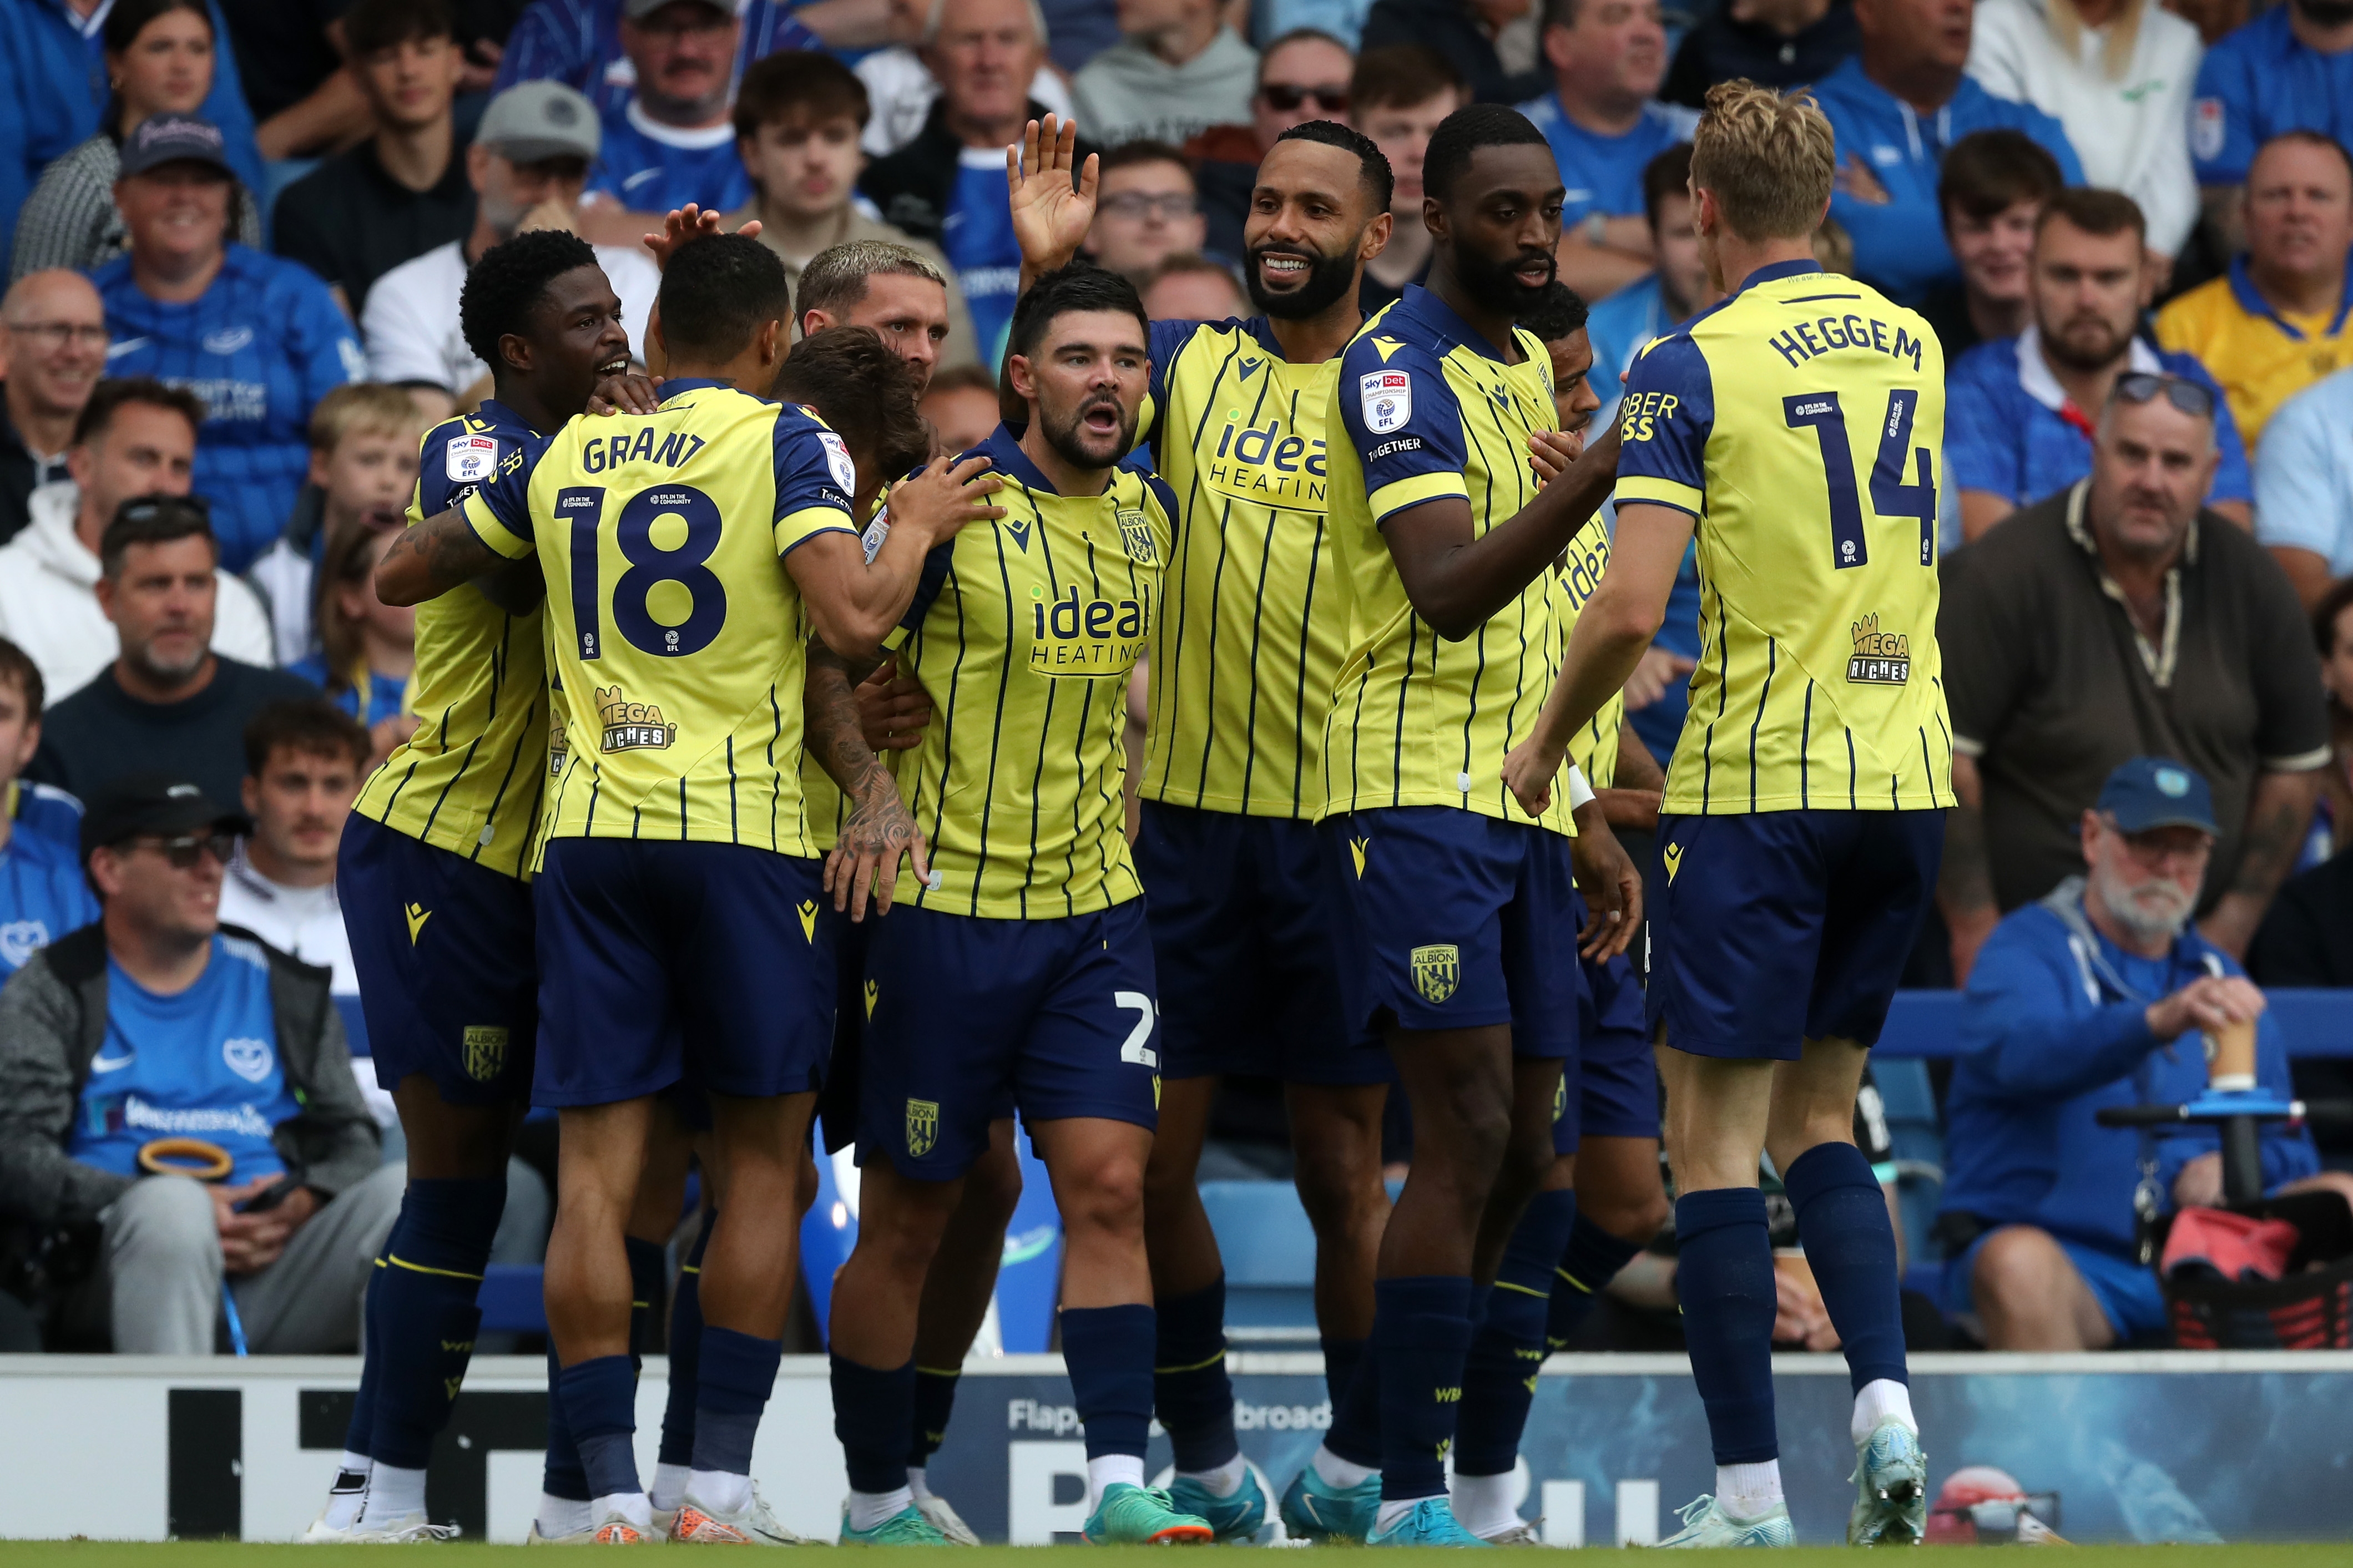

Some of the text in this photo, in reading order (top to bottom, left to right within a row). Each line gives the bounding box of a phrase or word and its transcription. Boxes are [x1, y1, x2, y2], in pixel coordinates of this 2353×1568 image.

[1769, 315, 1921, 373] HEGGEM
[1365, 377, 1405, 390] sky bet
[1365, 388, 1406, 399] CHAMPIONSHIP
[1622, 392, 1679, 423] RBER
[1805, 406, 1833, 415] COMMUNITY
[1379, 418, 1394, 427] EFL
[1624, 417, 1654, 442] SS
[451, 448, 493, 457] CHAMPIONSHIP
[452, 439, 491, 450] sky bet
[583, 427, 705, 474] GRANT
[825, 437, 838, 448] sky
[1217, 409, 1326, 477] idea
[1369, 438, 1421, 463] TOGETHER
[1209, 463, 1326, 502] HEATIN
[1783, 389, 1936, 569] 14
[447, 485, 478, 508] TOGET
[1121, 517, 1145, 527] ALBION
[554, 483, 726, 660] 18
[1561, 542, 1609, 611] idea
[1030, 584, 1149, 639] ideal
[1855, 634, 1910, 656] MEGA
[1850, 660, 1908, 681] RICHES
[600, 702, 664, 725] MEGA
[605, 727, 663, 748] RICHES
[1415, 953, 1454, 964] ALBION
[1114, 992, 1160, 1069] 2
[1234, 1399, 1332, 1430] broad
